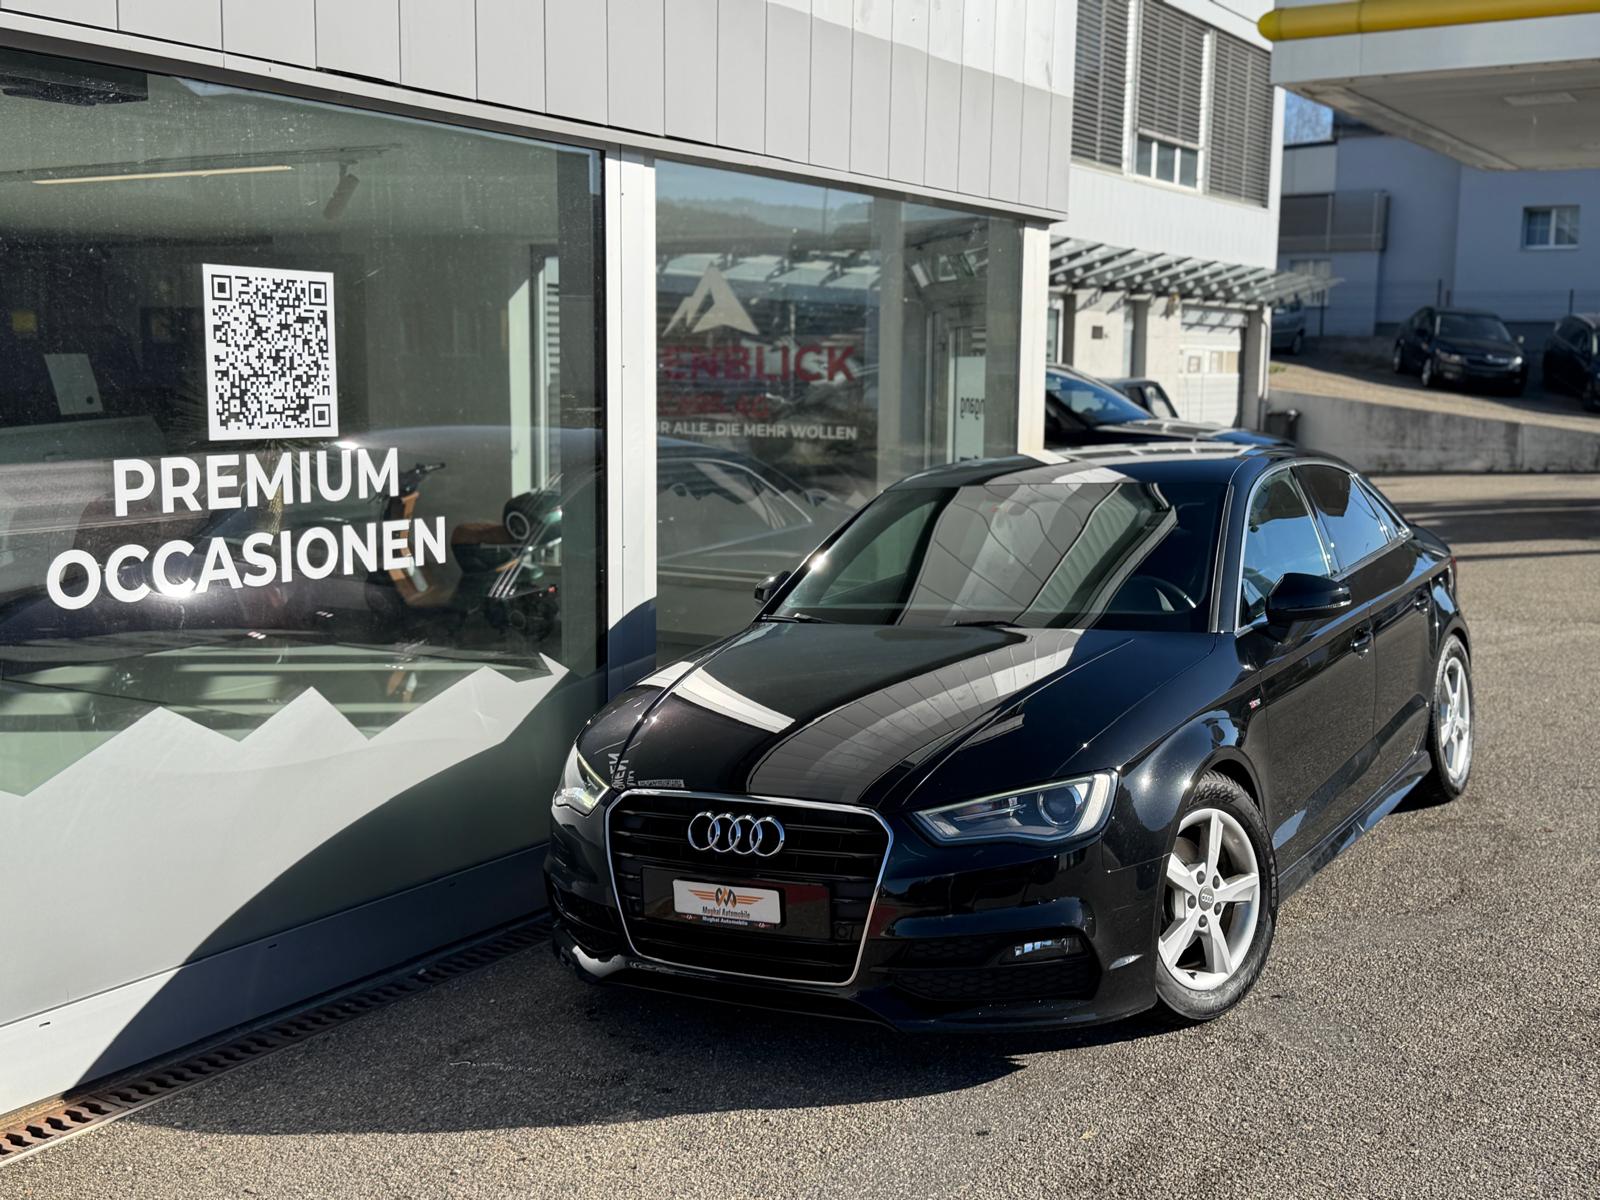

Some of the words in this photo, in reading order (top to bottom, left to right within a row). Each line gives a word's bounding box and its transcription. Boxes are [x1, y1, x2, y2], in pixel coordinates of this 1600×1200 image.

[673, 421, 712, 438] ALLE,
[715, 424, 740, 437] DIE
[744, 423, 786, 438] MEHR
[790, 424, 858, 440] WOLLEN
[113, 447, 399, 517] PREMIUM
[46, 516, 446, 610] OCCASIONEN
